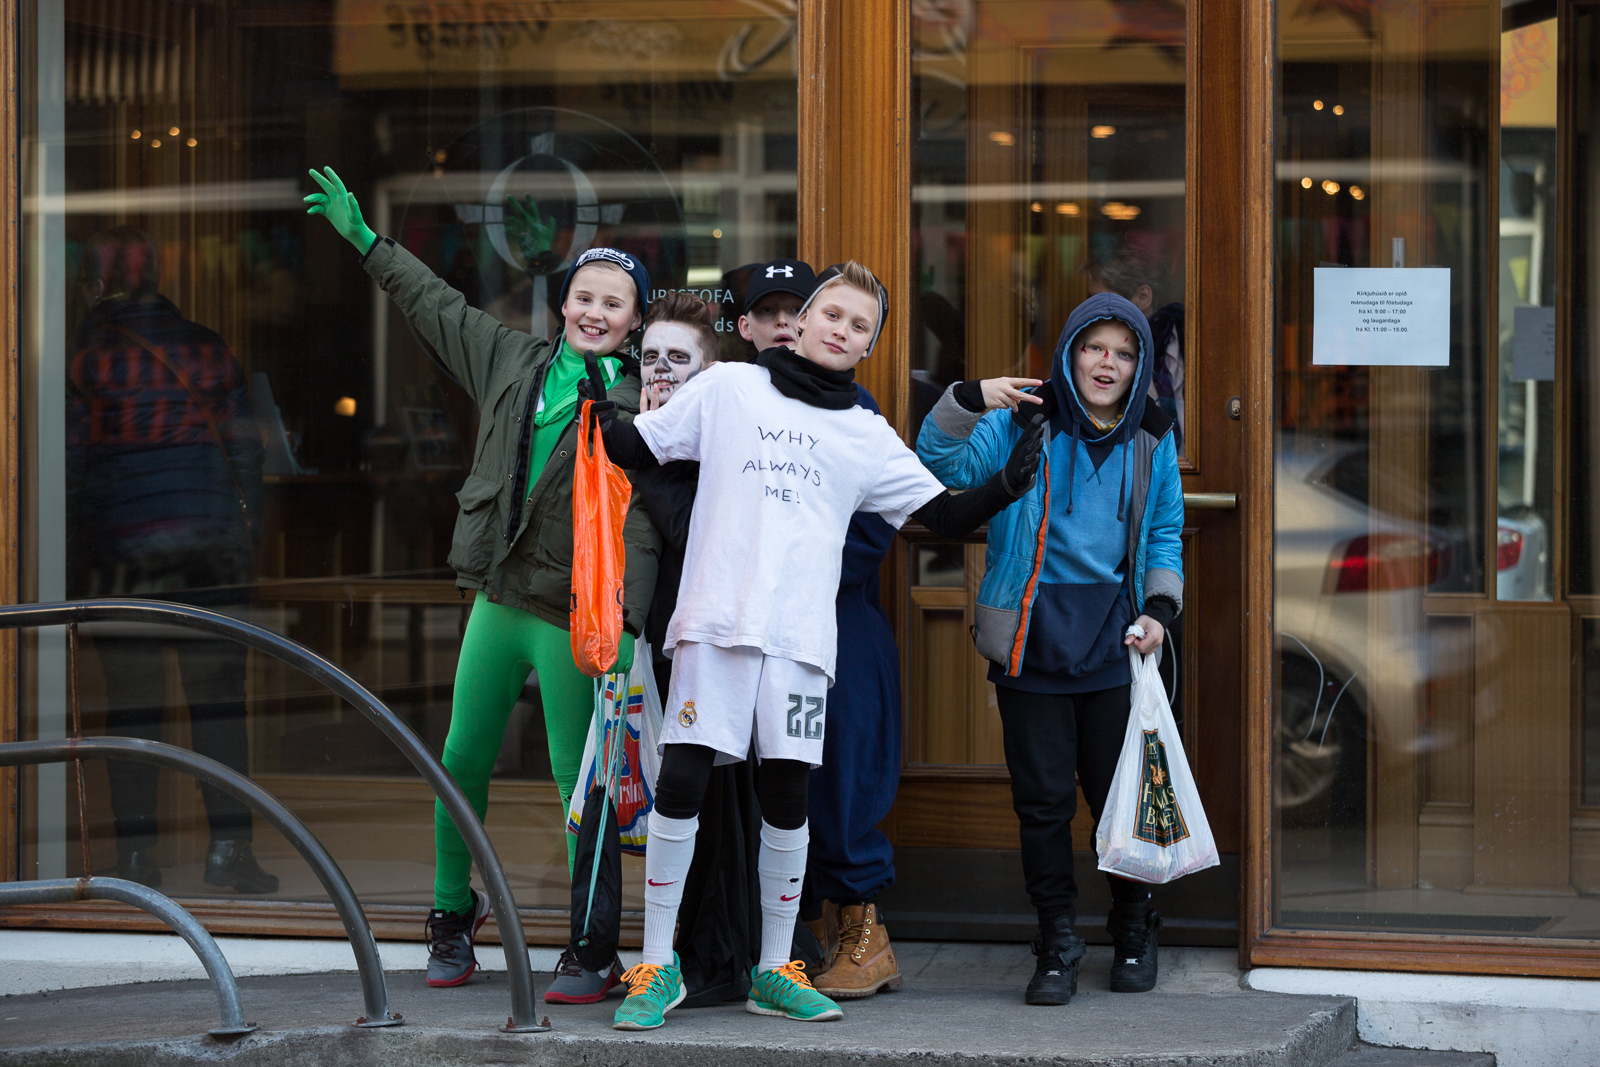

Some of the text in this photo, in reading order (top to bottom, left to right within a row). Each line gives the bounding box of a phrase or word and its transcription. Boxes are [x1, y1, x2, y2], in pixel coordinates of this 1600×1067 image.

[757, 426, 820, 450] WHY
[742, 459, 821, 487] ALWAYS
[786, 693, 825, 740] 22
